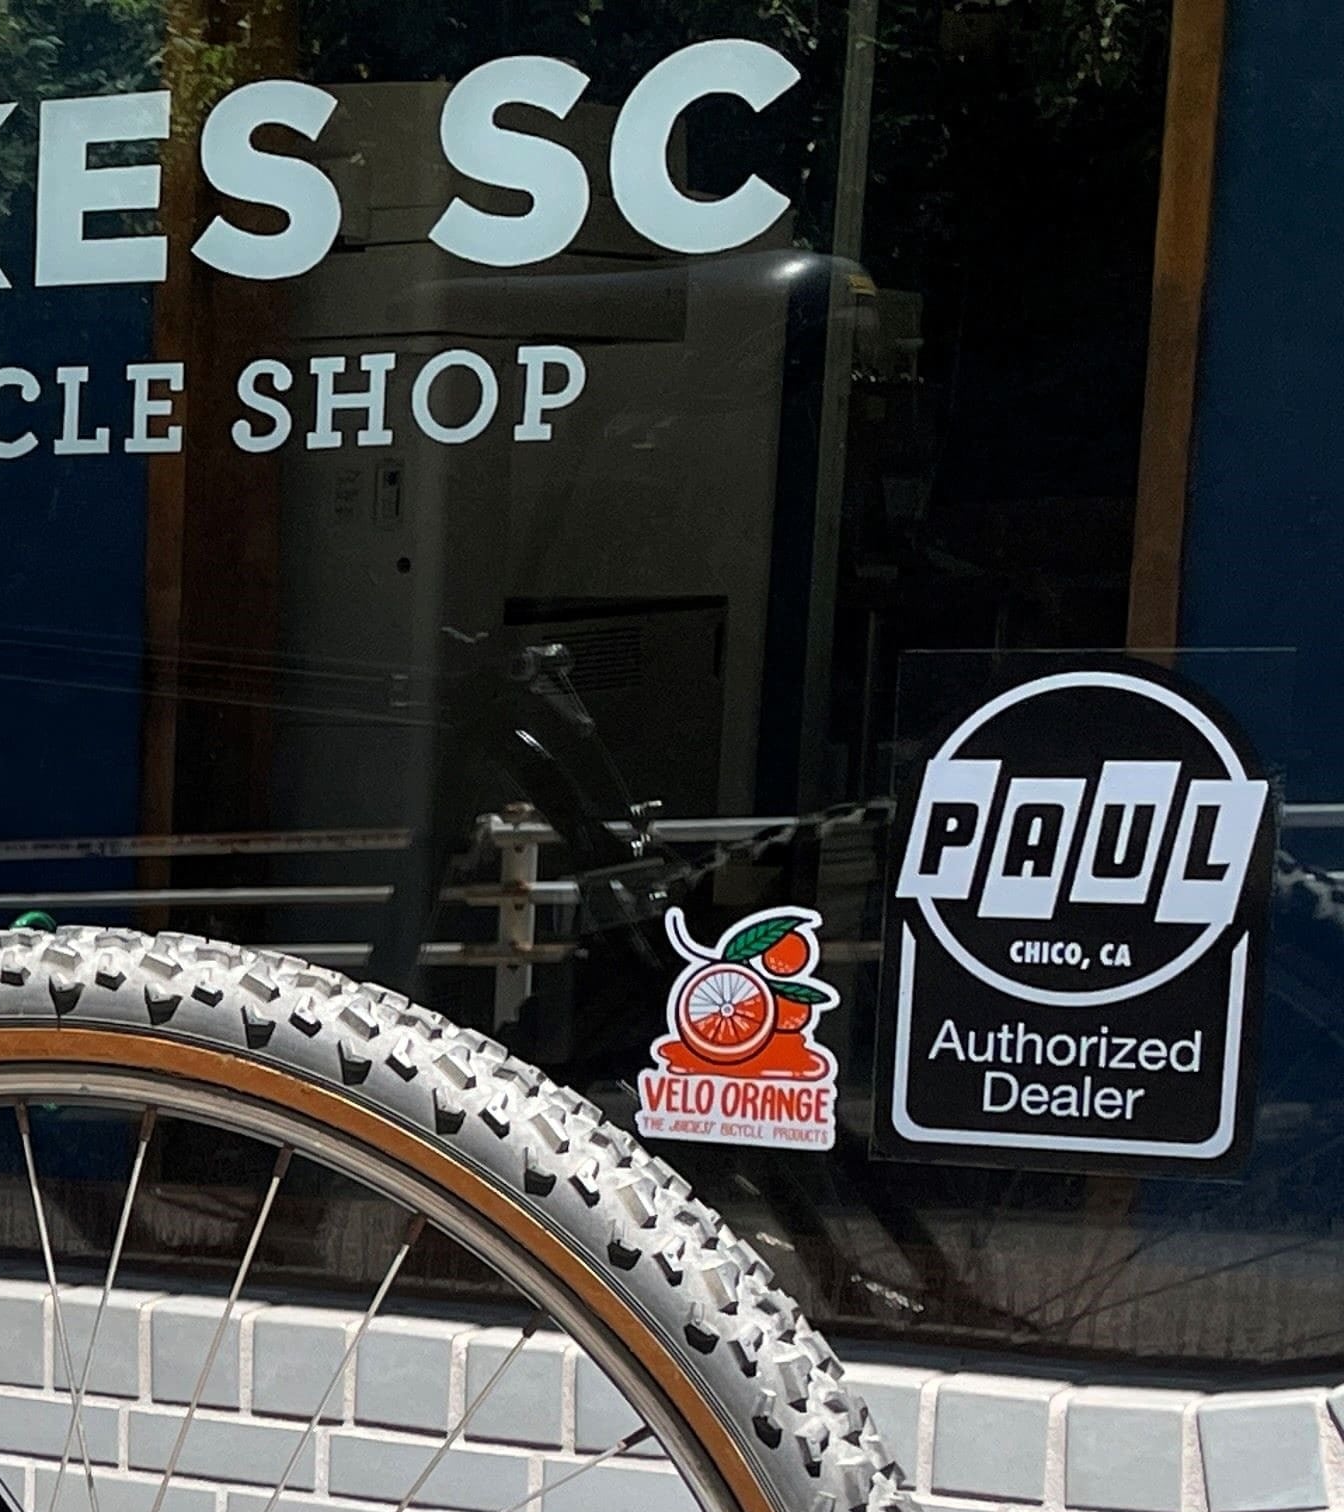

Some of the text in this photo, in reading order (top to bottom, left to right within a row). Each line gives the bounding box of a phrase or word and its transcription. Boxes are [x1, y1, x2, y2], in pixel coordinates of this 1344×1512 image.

[428, 38, 801, 268] SC
[232, 345, 587, 453] SHOP
[918, 802, 1229, 881] PAUL
[1009, 939, 1132, 970] CHICO, CA
[928, 1018, 1203, 1074] Authorized
[644, 1076, 830, 1124] VELO ORANGE
[981, 1071, 1145, 1122] Dealer
[642, 1116, 666, 1131] THE
[720, 1122, 764, 1139] BICYCLE
[772, 1127, 829, 1145] PRODUCTS
